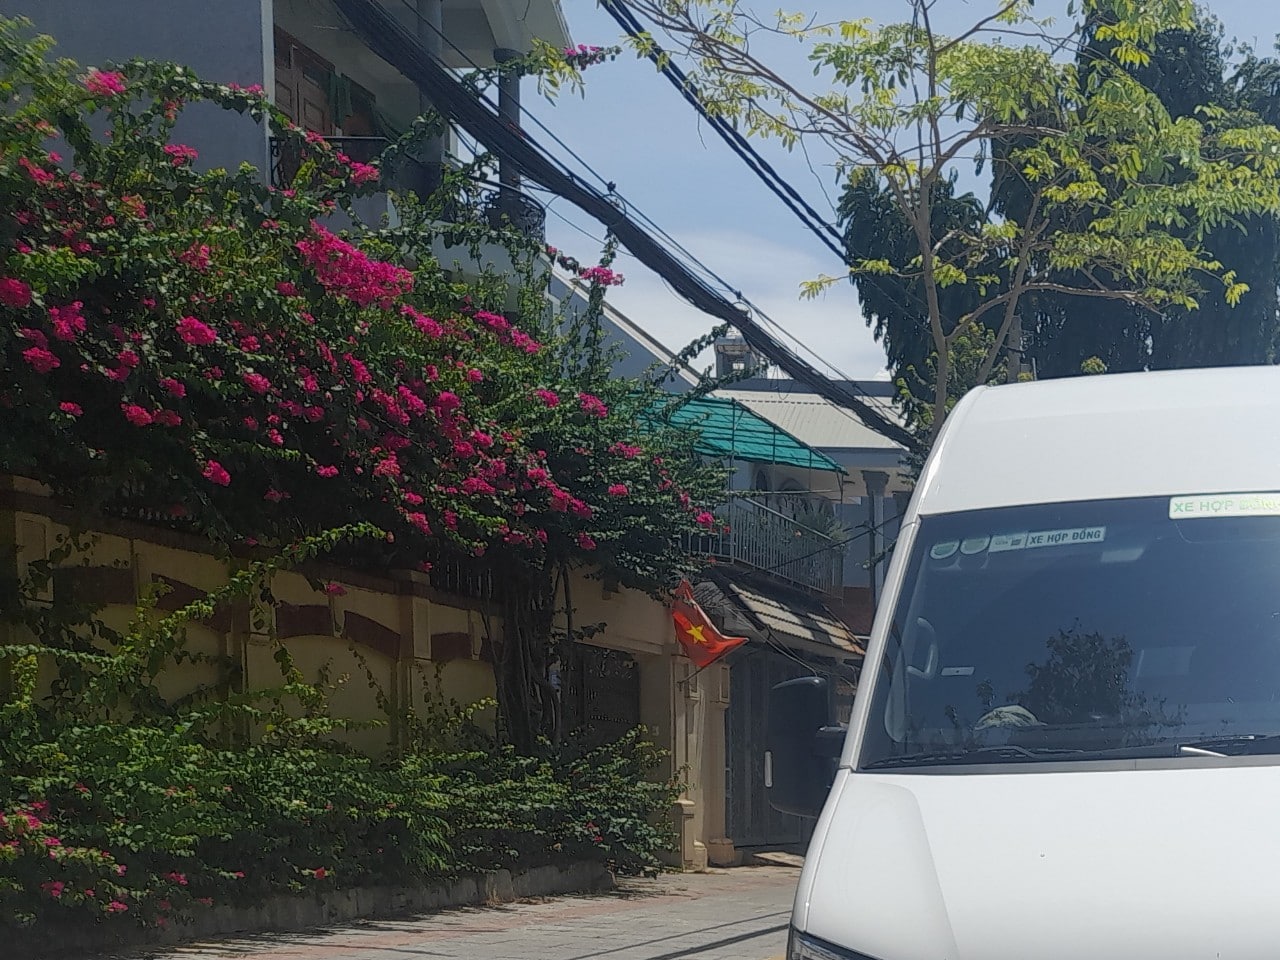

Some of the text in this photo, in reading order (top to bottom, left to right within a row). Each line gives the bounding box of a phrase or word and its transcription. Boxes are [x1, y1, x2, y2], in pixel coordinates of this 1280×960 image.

[1173, 502, 1194, 513] XE
[1029, 534, 1044, 545] XE
[1072, 529, 1101, 540] ĐỒNG
